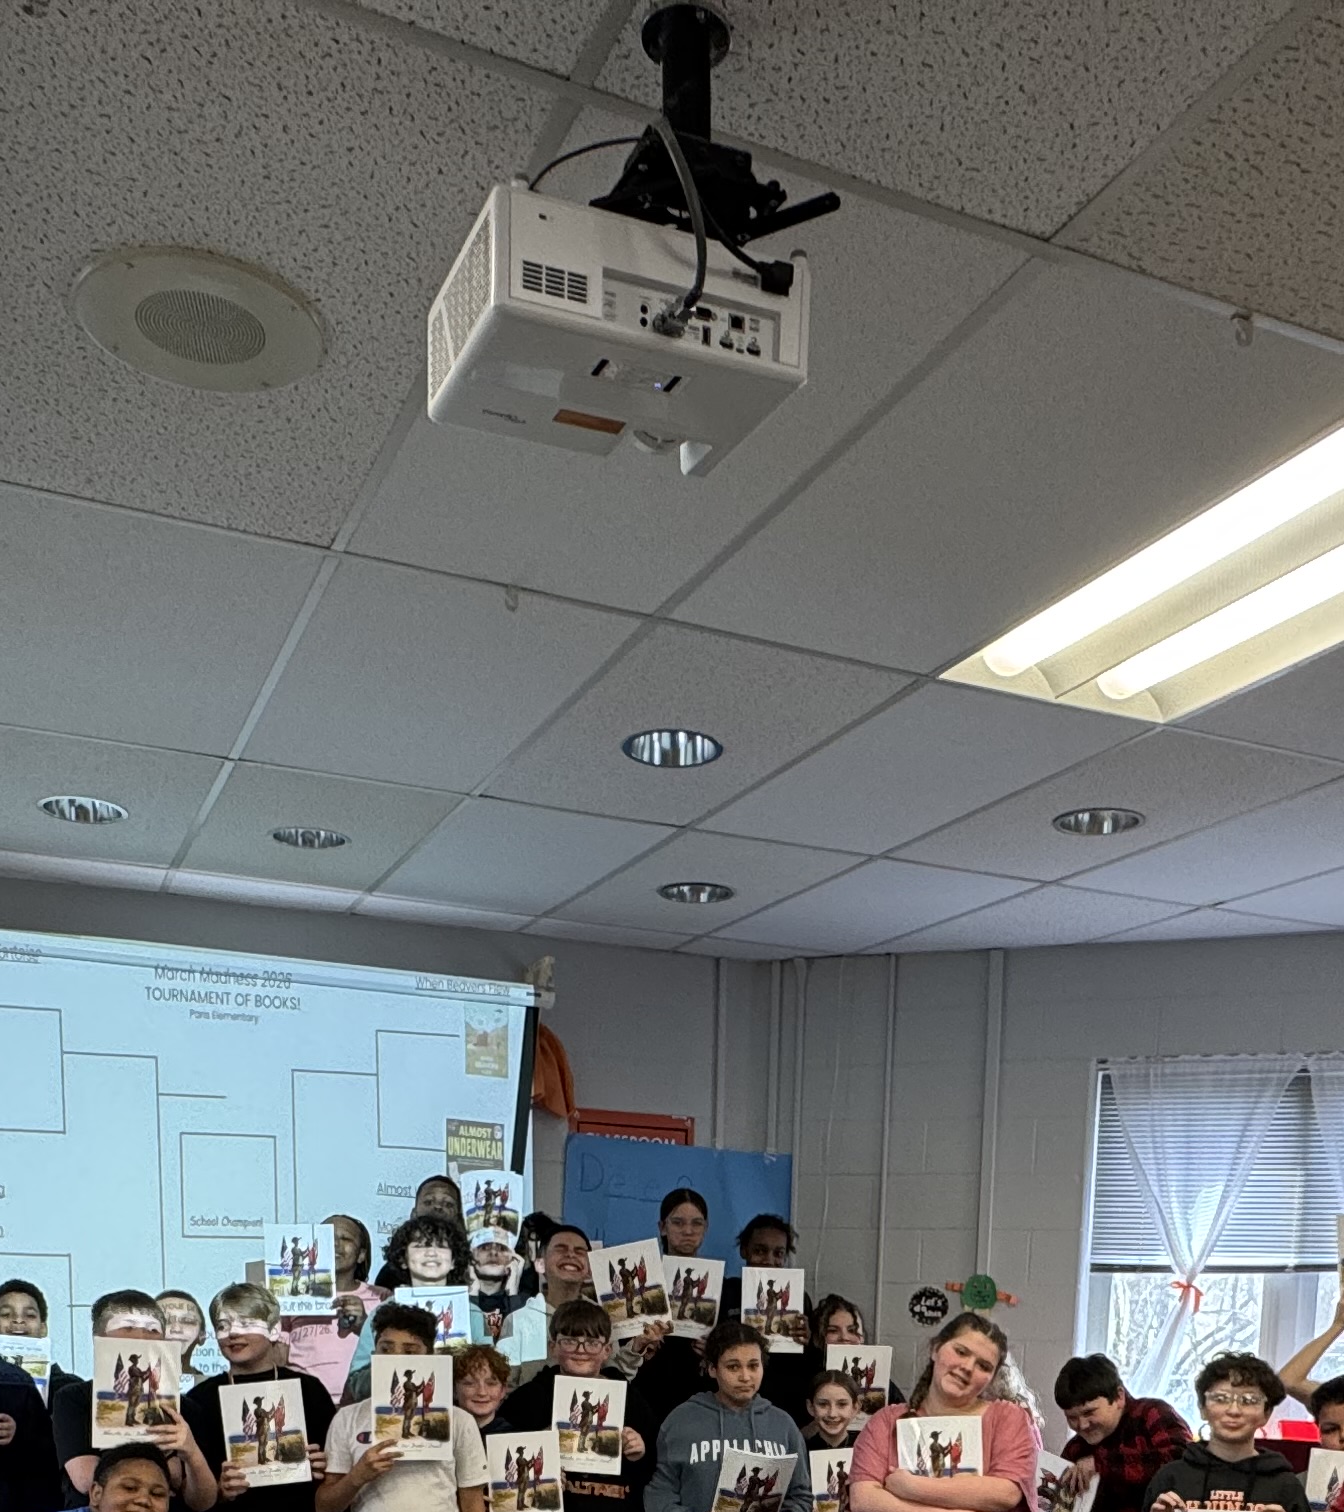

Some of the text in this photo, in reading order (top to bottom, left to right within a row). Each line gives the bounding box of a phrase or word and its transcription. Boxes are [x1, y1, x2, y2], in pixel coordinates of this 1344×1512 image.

[155, 965, 195, 983] March
[200, 967, 257, 987] Madness
[145, 986, 301, 1010] TOURNAMENT OF BOOKS!
[212, 1011, 259, 1025] Elementary
[459, 1126, 493, 1140] ALMOST
[448, 1137, 503, 1160] UNDERWEAR
[377, 1183, 412, 1195] Almost
[190, 1215, 218, 1226] School
